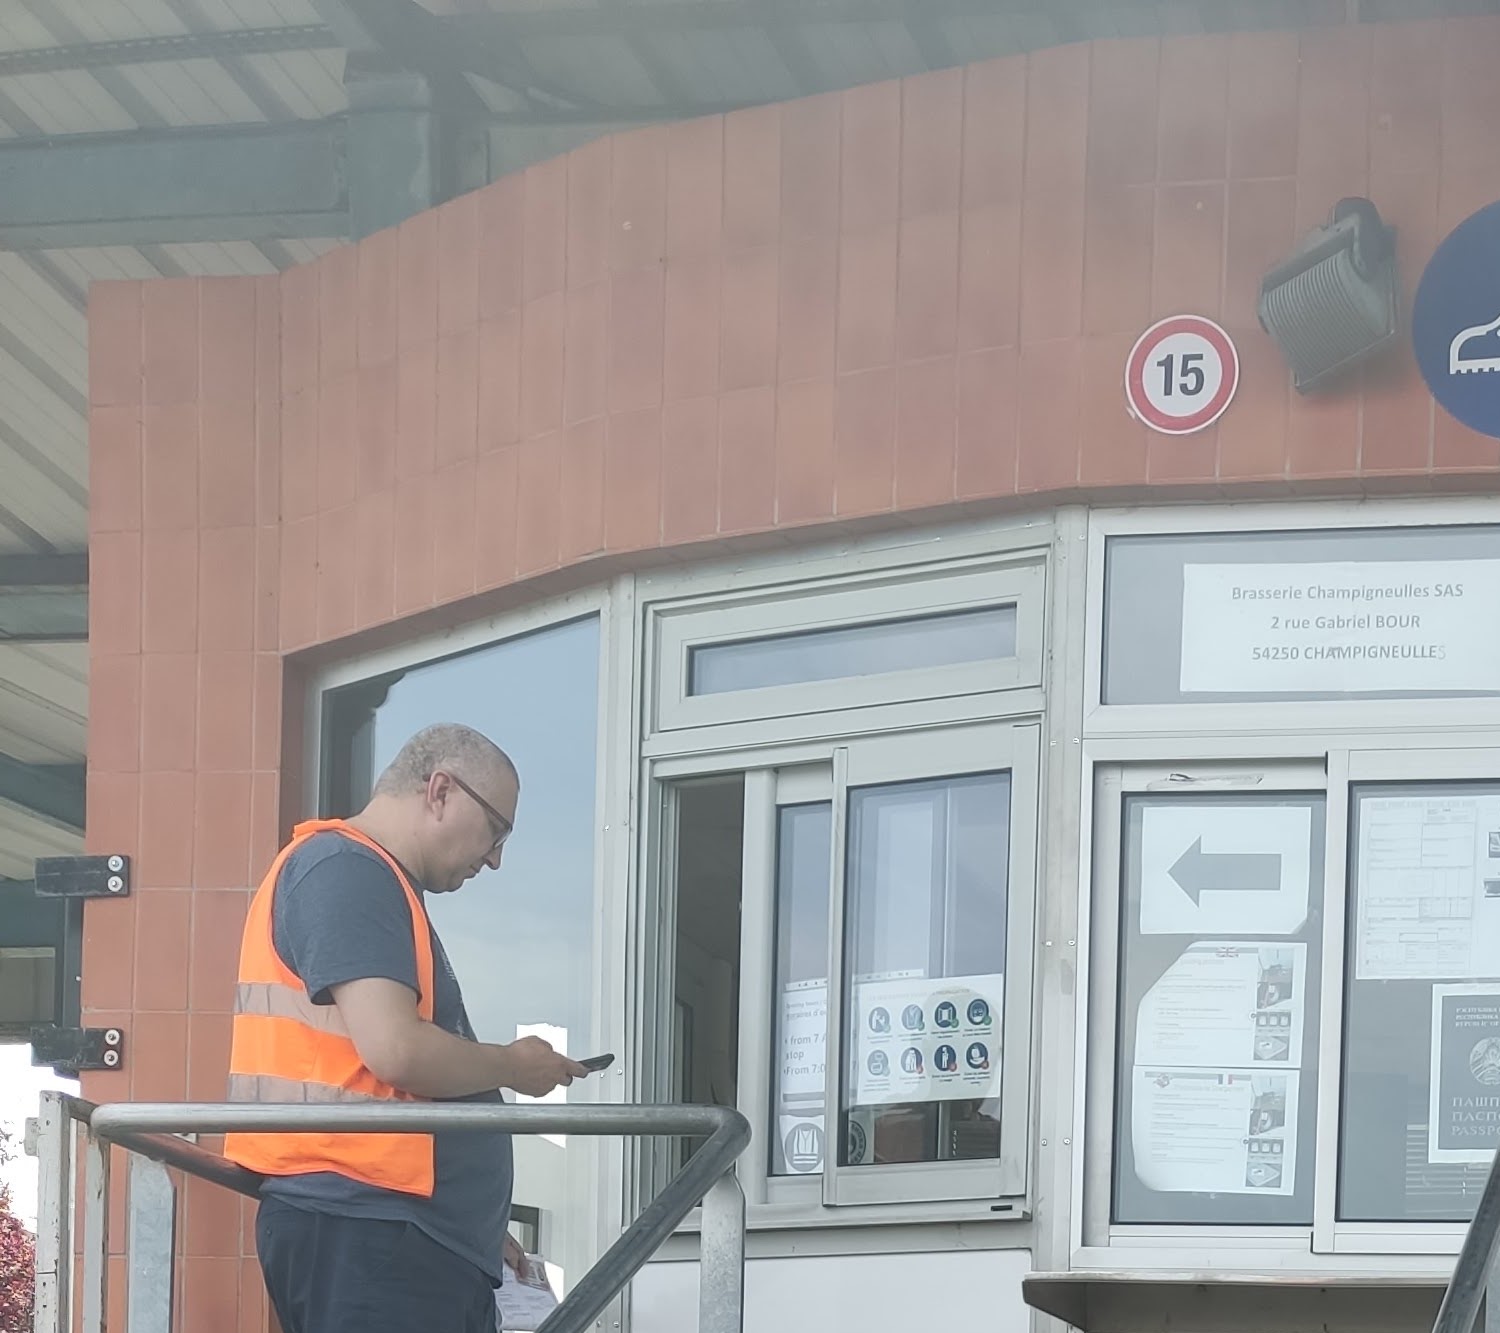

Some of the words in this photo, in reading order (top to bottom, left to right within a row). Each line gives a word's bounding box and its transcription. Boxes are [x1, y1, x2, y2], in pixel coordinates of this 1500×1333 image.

[1157, 353, 1204, 396] 15
[1232, 586, 1302, 600] Brasserie
[1307, 584, 1430, 601] Champigneulles
[1434, 583, 1464, 597] SAS
[1270, 616, 1279, 629] 2
[1285, 618, 1310, 629] rue
[1315, 614, 1370, 629] Gabriel
[1375, 615, 1420, 629] BOUR
[1252, 646, 1299, 660] 54250
[1304, 645, 1446, 660] CHAMPIGNEULLES
[790, 1035, 811, 1045] from
